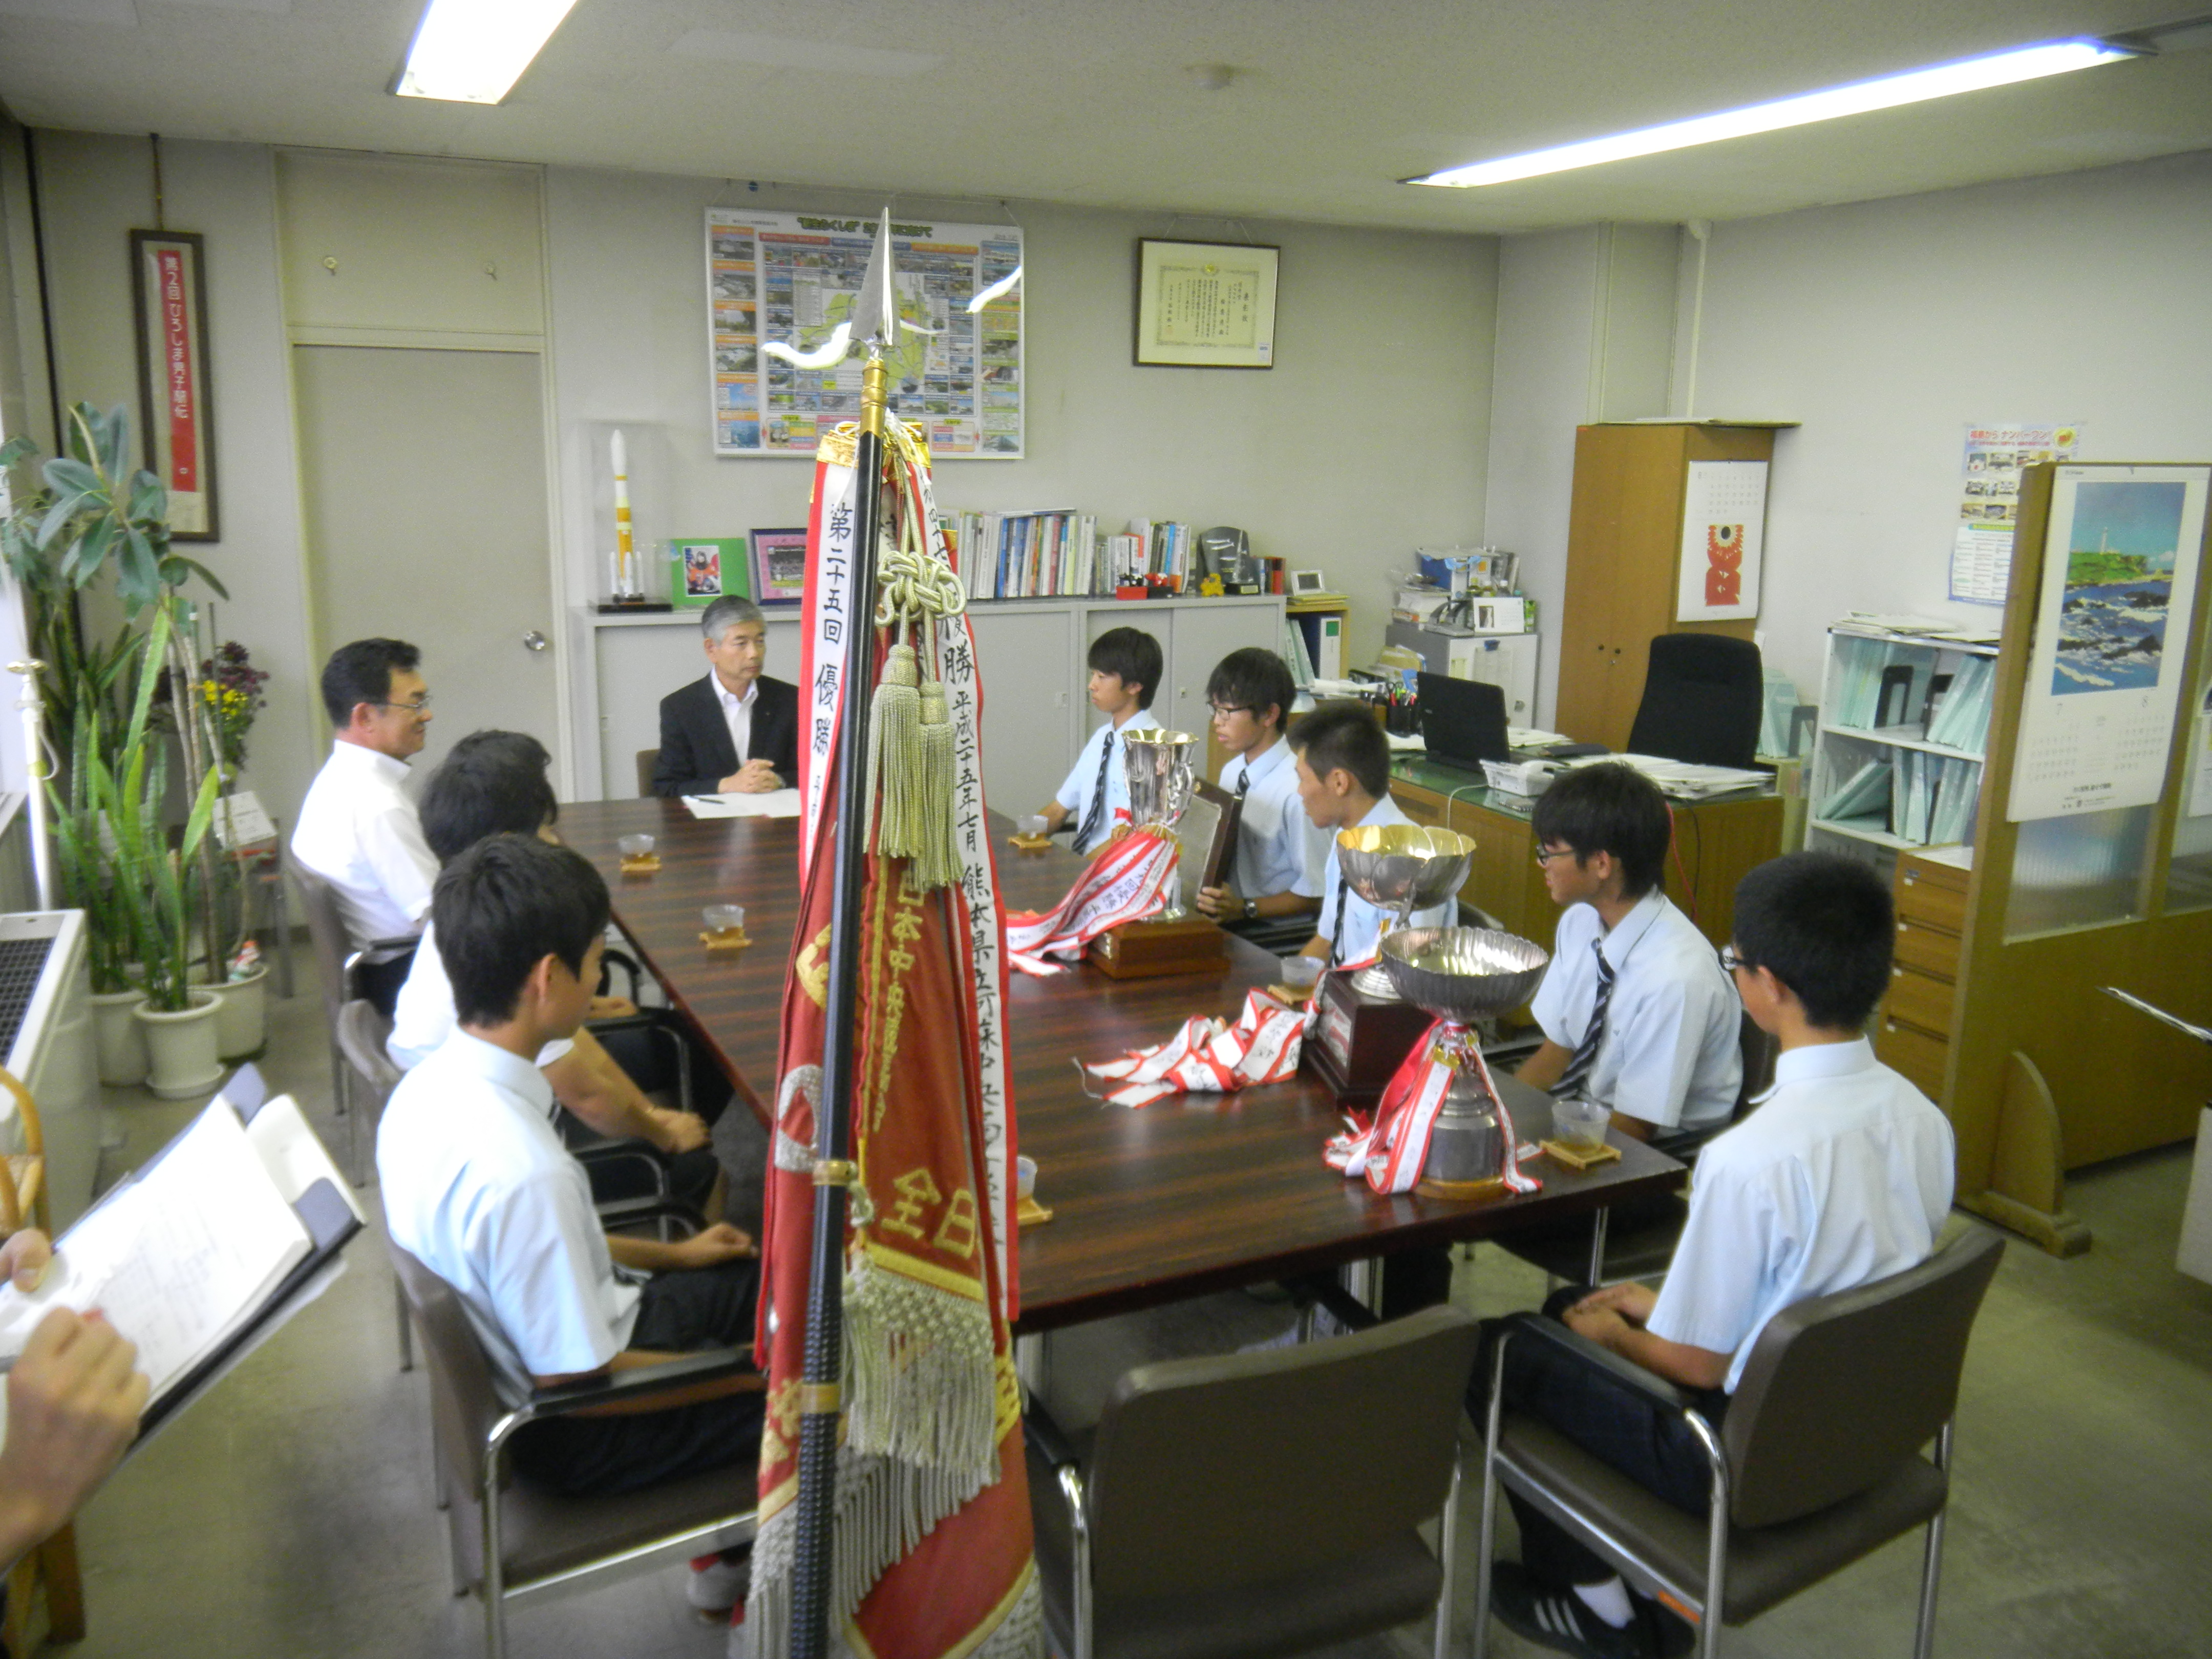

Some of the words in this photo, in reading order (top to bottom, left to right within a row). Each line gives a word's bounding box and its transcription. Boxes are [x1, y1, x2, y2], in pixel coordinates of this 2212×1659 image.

[824, 503, 854, 644] 第二十五回
[813, 663, 839, 757] 優勝
[952, 691, 980, 852] 平成二十五年七月
